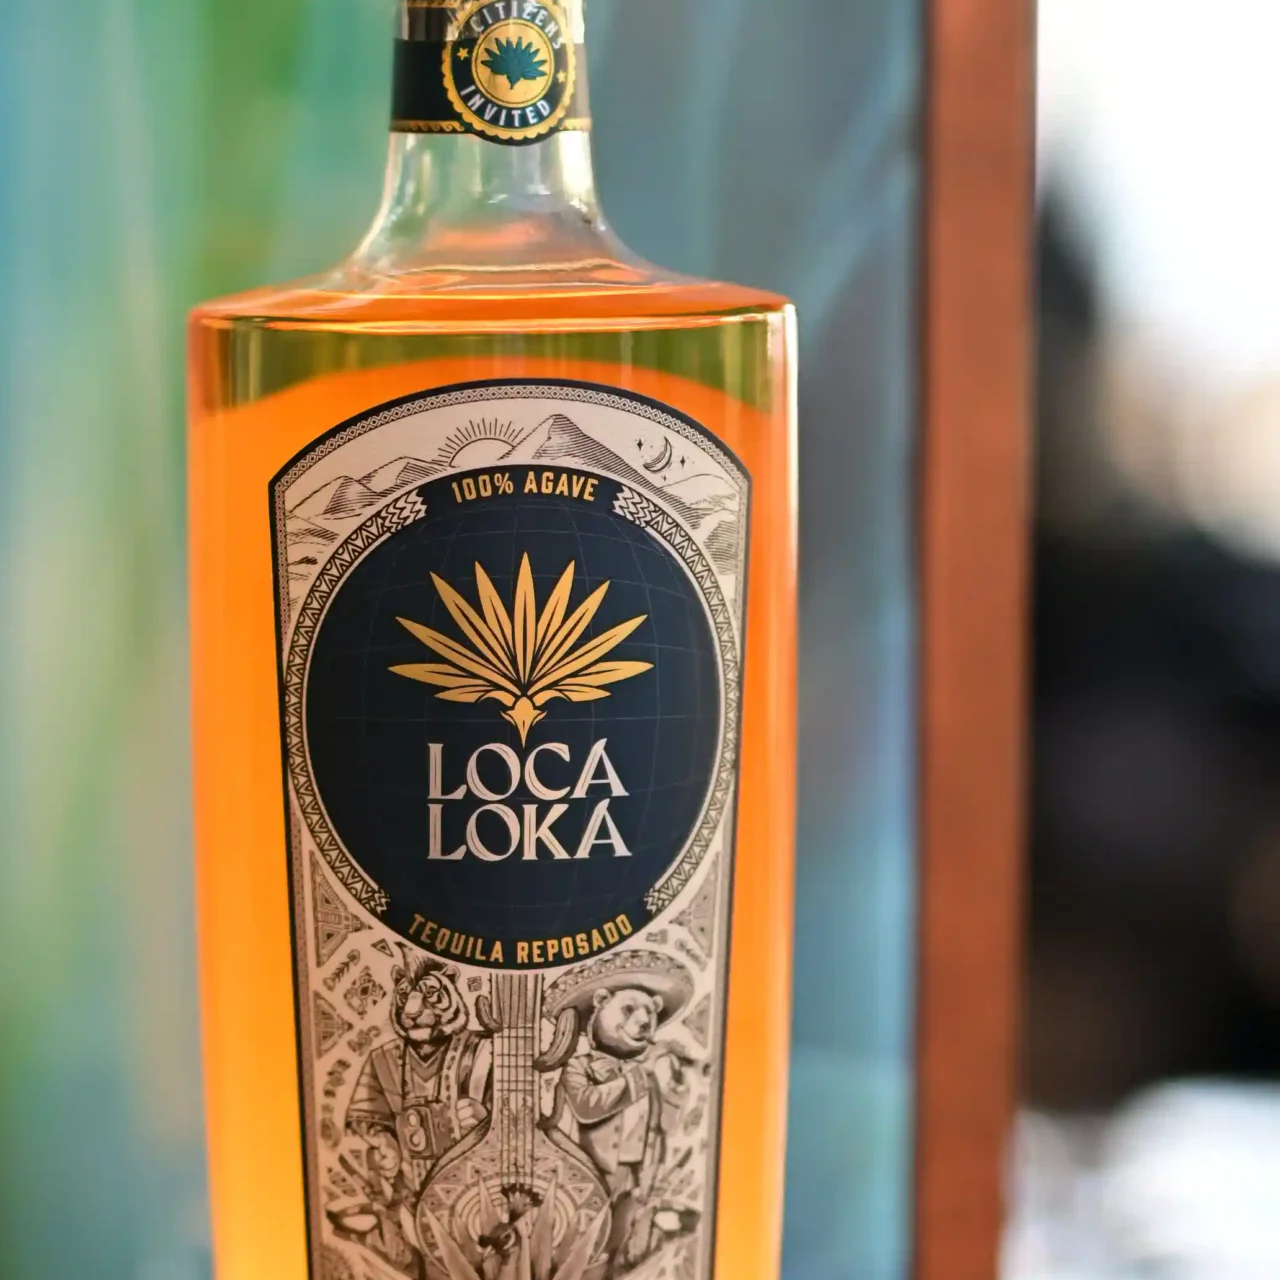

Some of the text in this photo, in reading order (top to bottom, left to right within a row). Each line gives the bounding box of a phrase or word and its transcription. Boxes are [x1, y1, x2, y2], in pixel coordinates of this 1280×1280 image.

[469, 0, 565, 51] CITIZENS
[459, 83, 551, 128] INVITED
[451, 470, 599, 503] 100% AGAVE
[427, 737, 630, 801] LOCA
[427, 798, 633, 862] LOKA
[408, 913, 633, 964] TEQUILA REPOSADO
